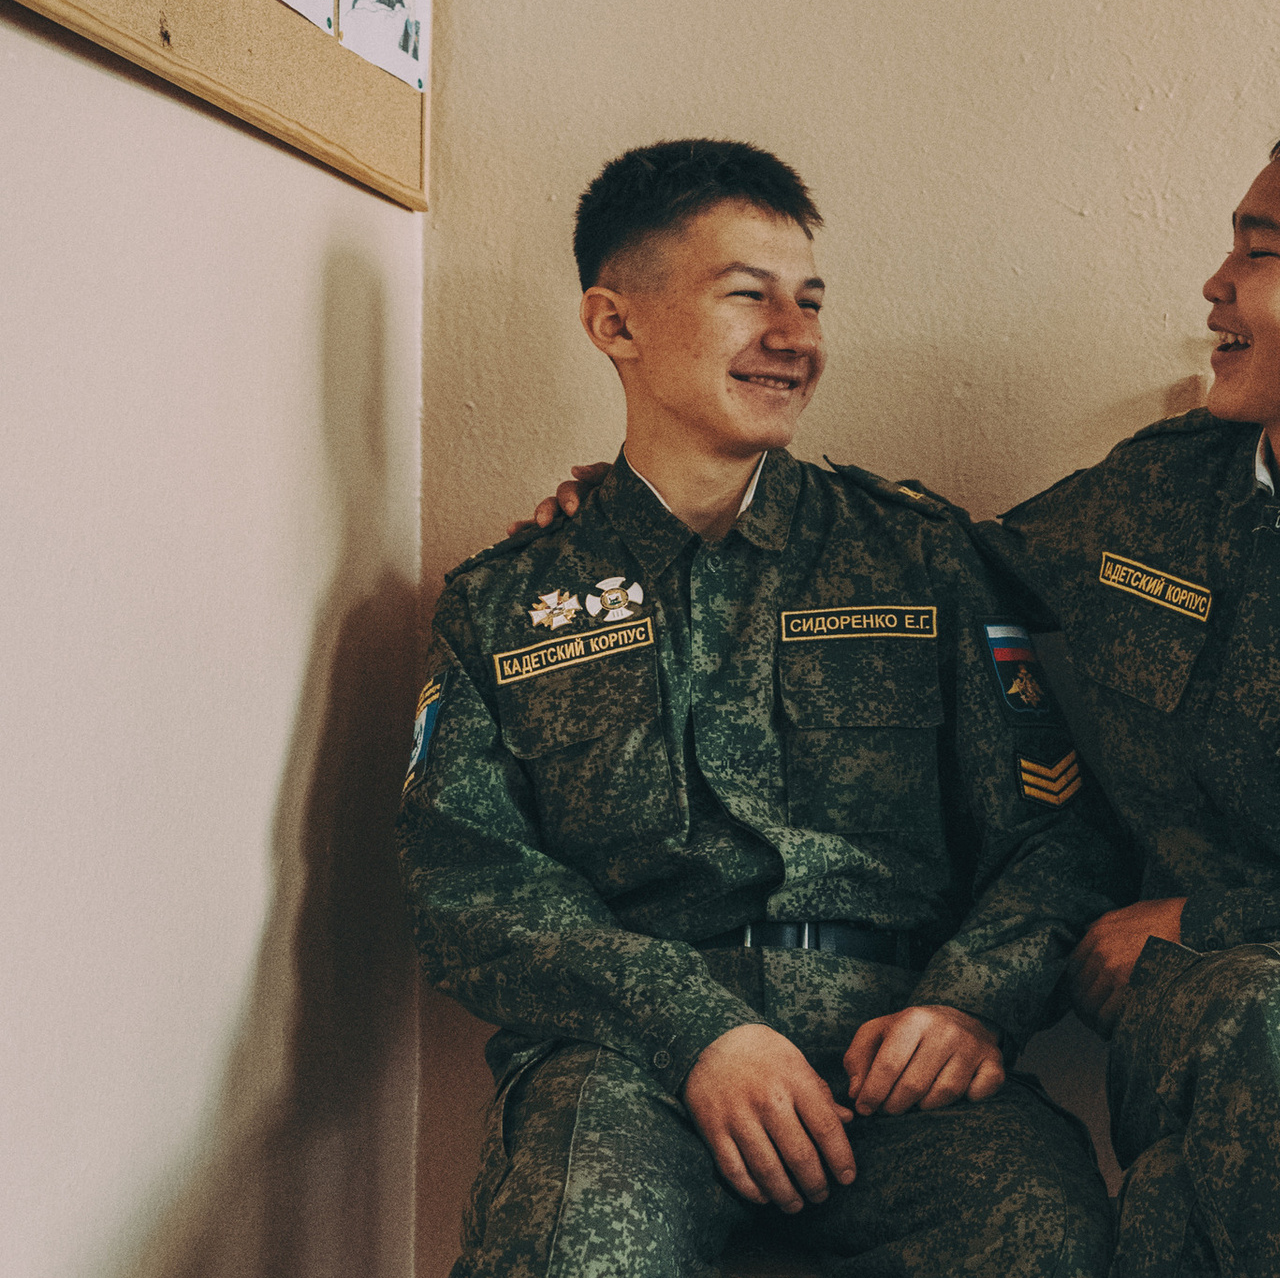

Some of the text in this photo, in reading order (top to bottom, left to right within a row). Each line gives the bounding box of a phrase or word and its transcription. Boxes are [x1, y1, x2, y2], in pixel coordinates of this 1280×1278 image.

[1164, 583, 1207, 613] КОРПУС
[789, 614, 931, 634] СИДОРЕНКО Е.Г.
[502, 626, 646, 676] КАДЕТСКИЙ КОРПУС
